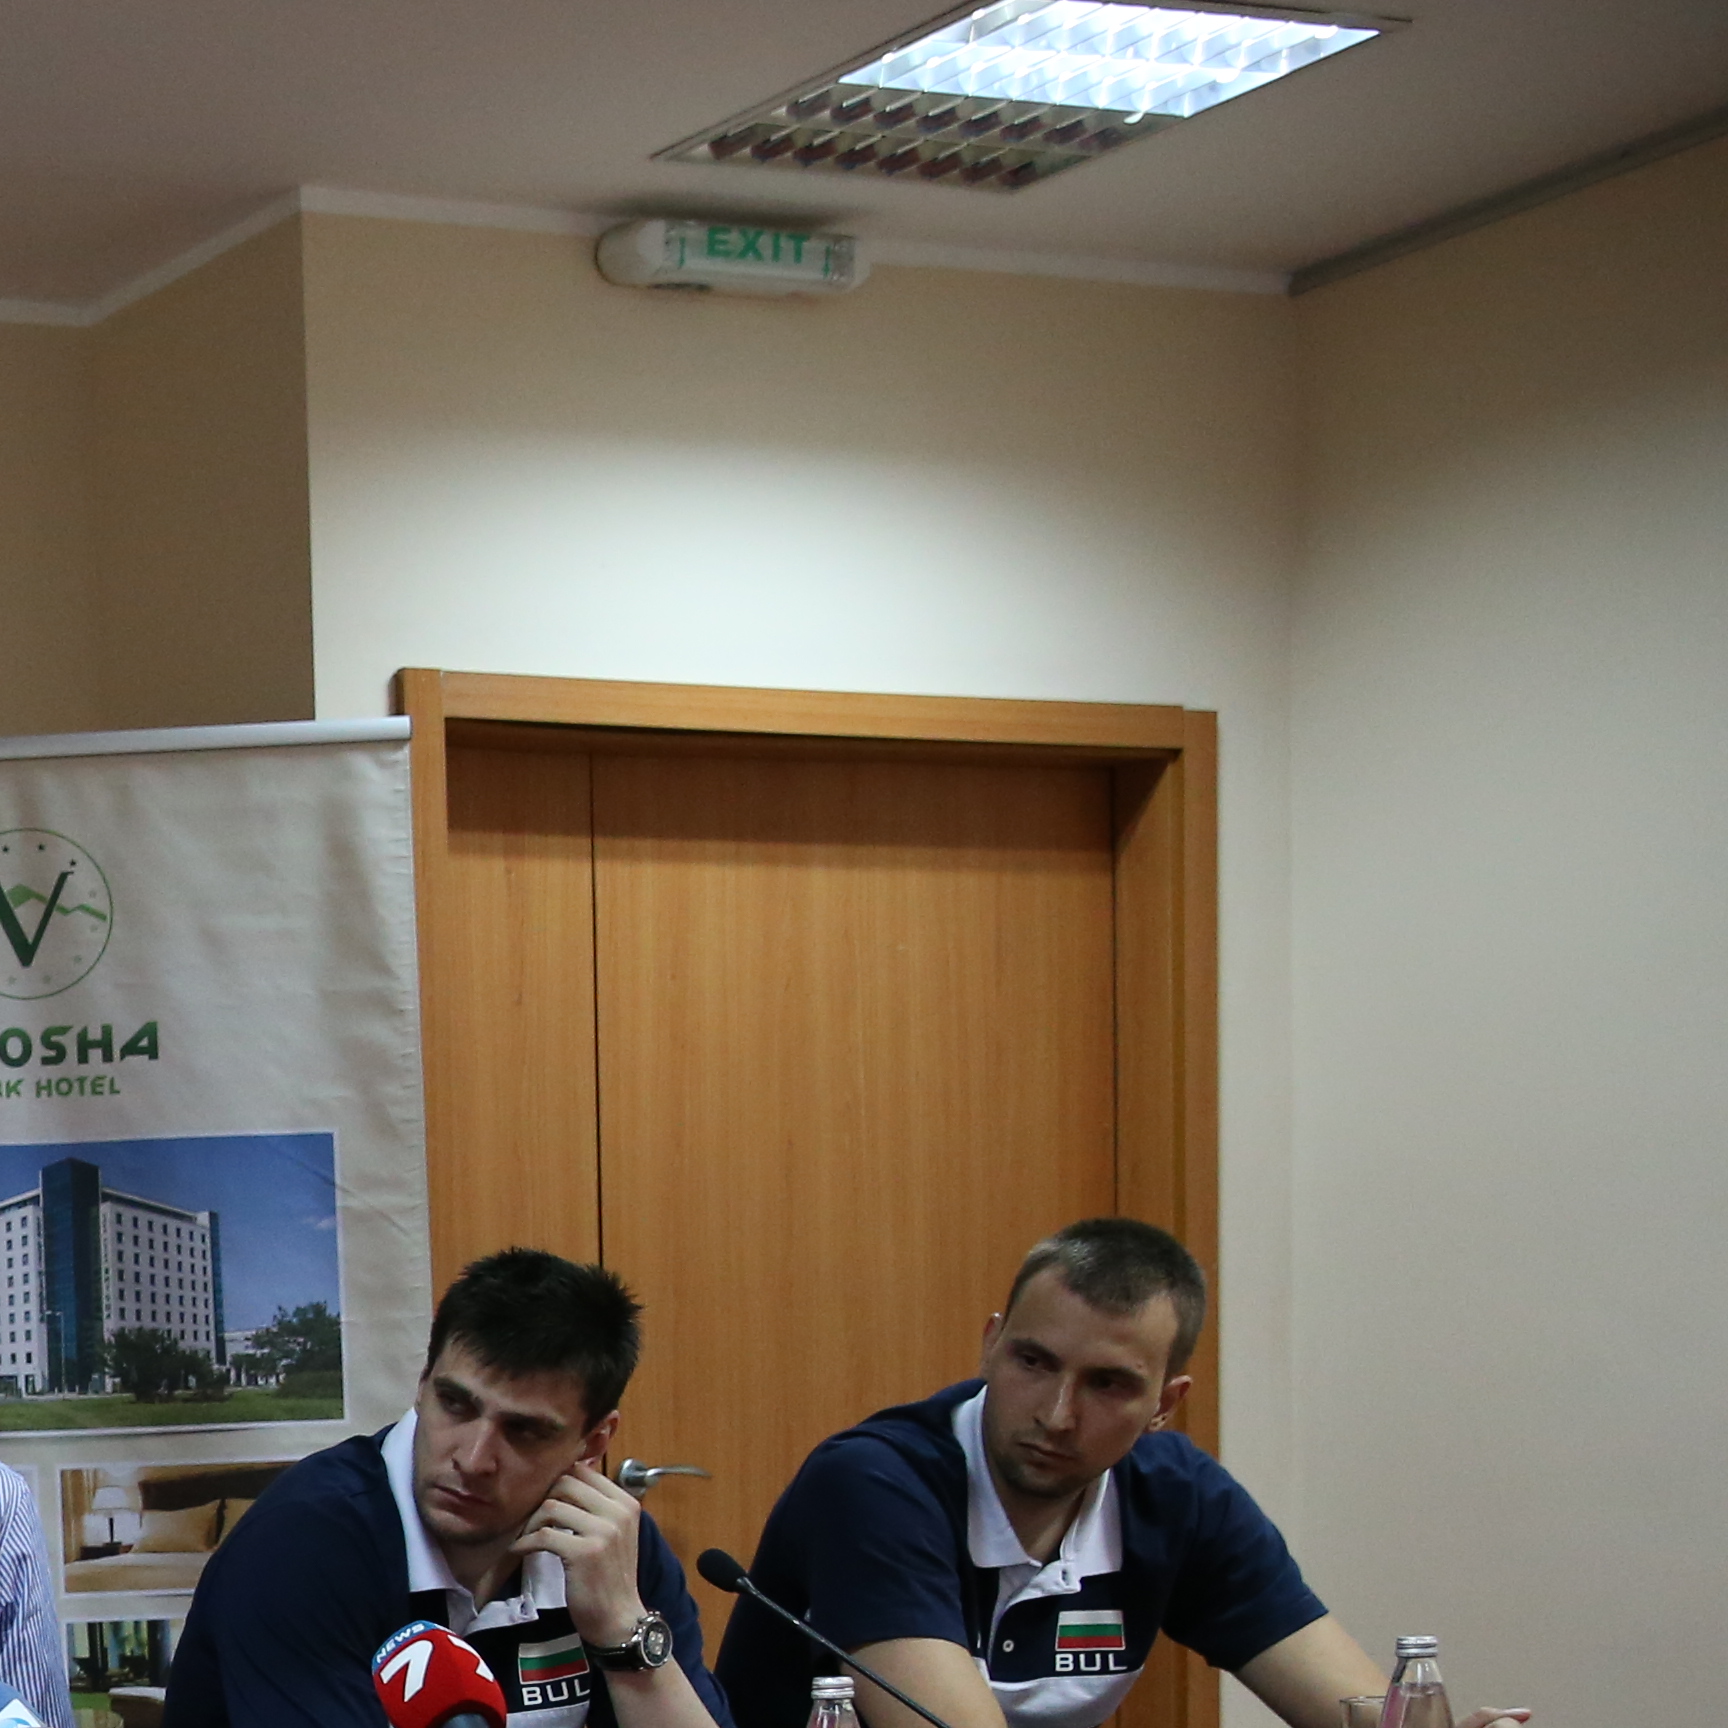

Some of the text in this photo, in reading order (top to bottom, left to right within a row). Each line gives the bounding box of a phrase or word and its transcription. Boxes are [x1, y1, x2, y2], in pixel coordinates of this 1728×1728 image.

[706, 226, 812, 264] EXIT
[35, 1075, 121, 1098] HOTEL
[376, 1623, 425, 1663] NEWS
[379, 1640, 434, 1702] 7
[1055, 1653, 1128, 1672] BUL
[522, 1679, 591, 1706] BUL
